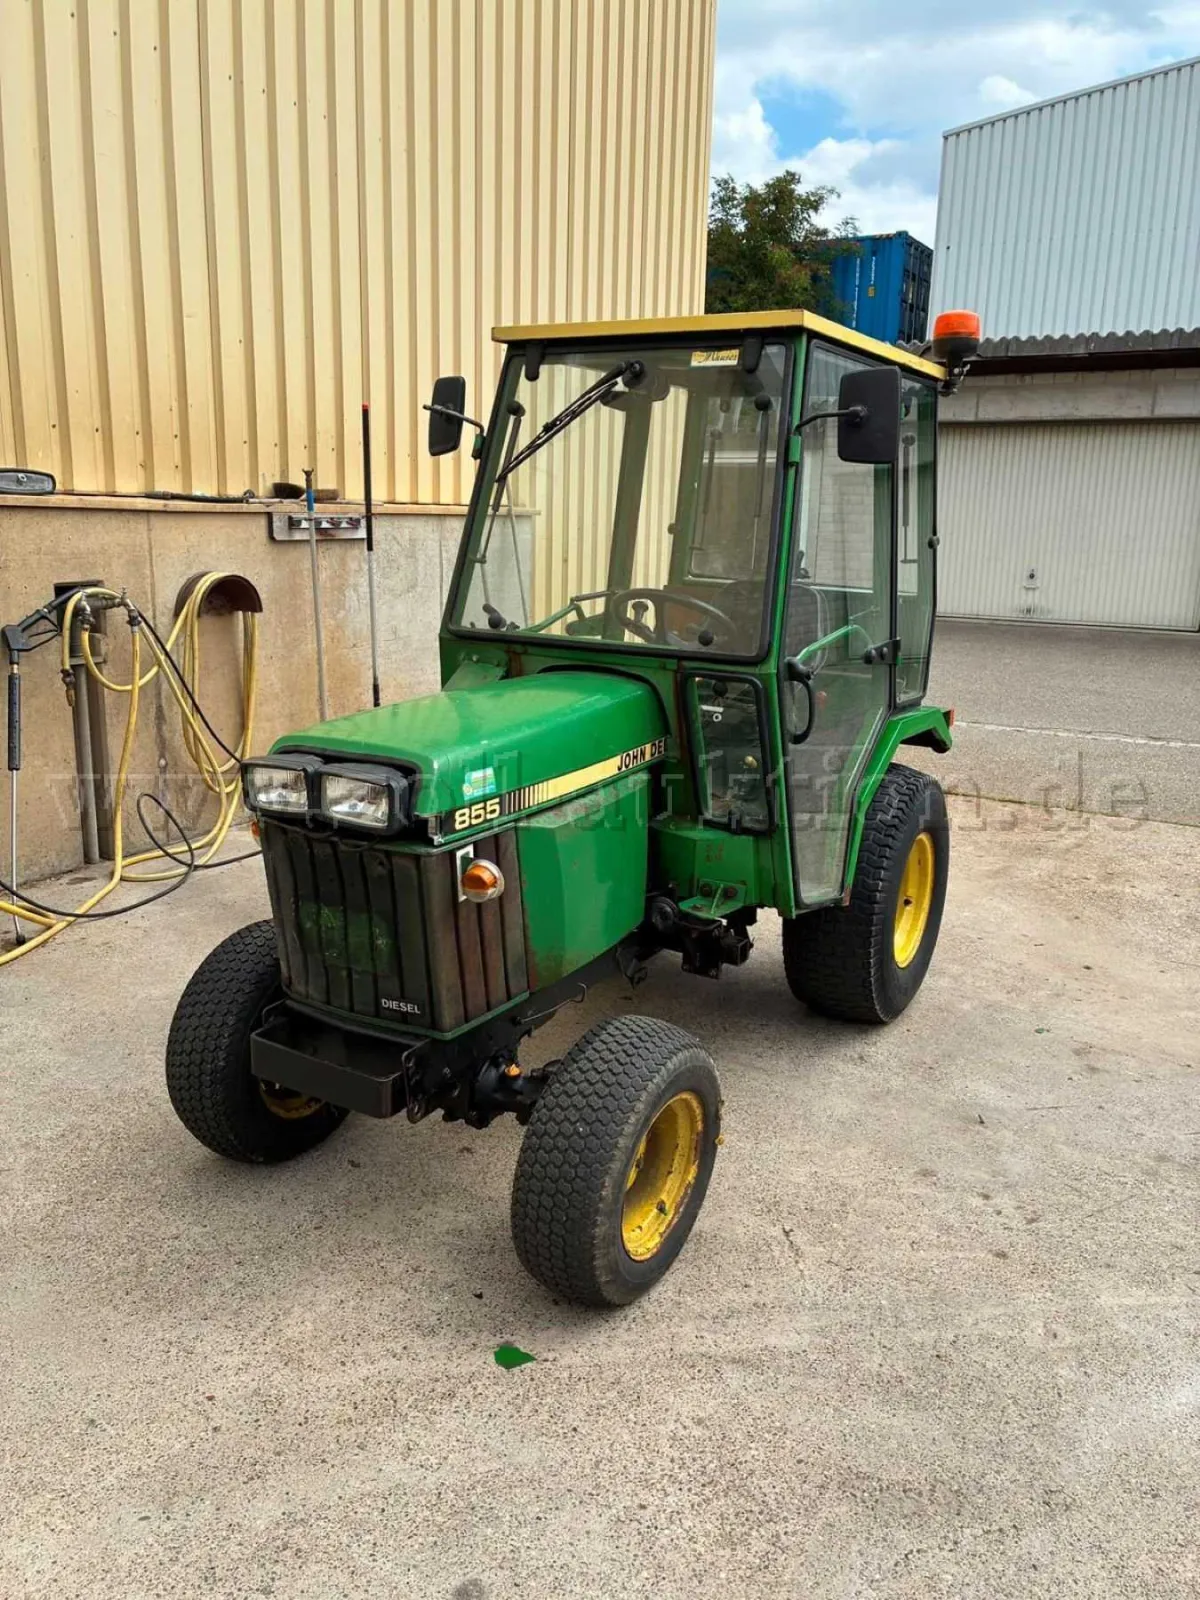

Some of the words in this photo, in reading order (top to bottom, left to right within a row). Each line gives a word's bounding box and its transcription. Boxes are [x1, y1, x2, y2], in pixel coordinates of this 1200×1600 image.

[617, 747, 647, 771] JOHN
[650, 739, 666, 757] DE
[455, 798, 500, 831] 855
[381, 998, 421, 1014] DIESEL
